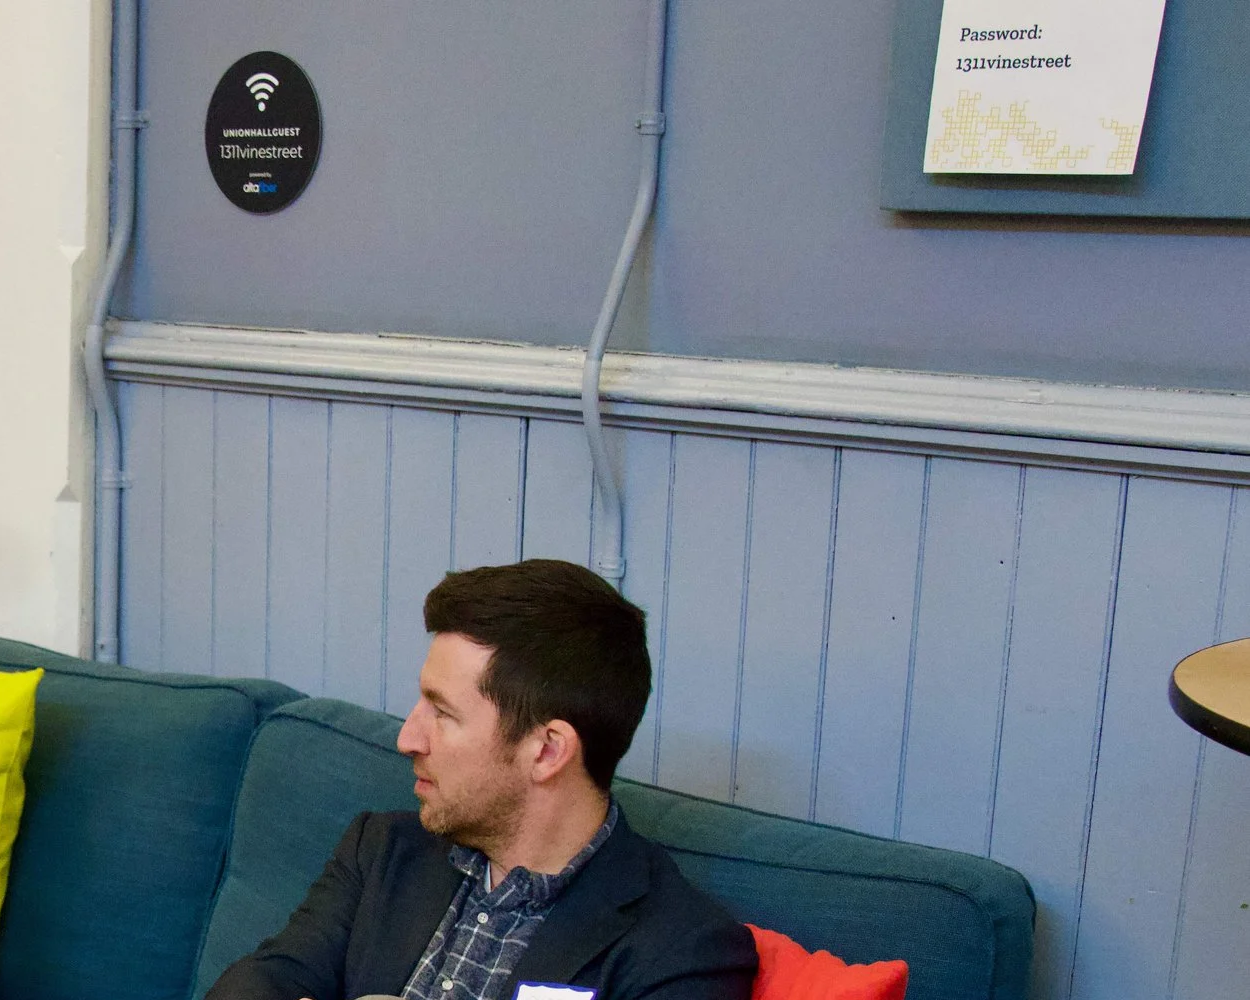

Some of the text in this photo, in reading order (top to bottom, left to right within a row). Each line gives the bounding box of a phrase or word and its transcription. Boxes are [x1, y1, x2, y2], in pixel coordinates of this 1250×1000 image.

[959, 24, 1043, 42] Password:
[955, 54, 1072, 72] 1311vinestreet
[222, 127, 301, 138] UNIONHALLGUEST
[219, 144, 303, 159] 1311vinestreet
